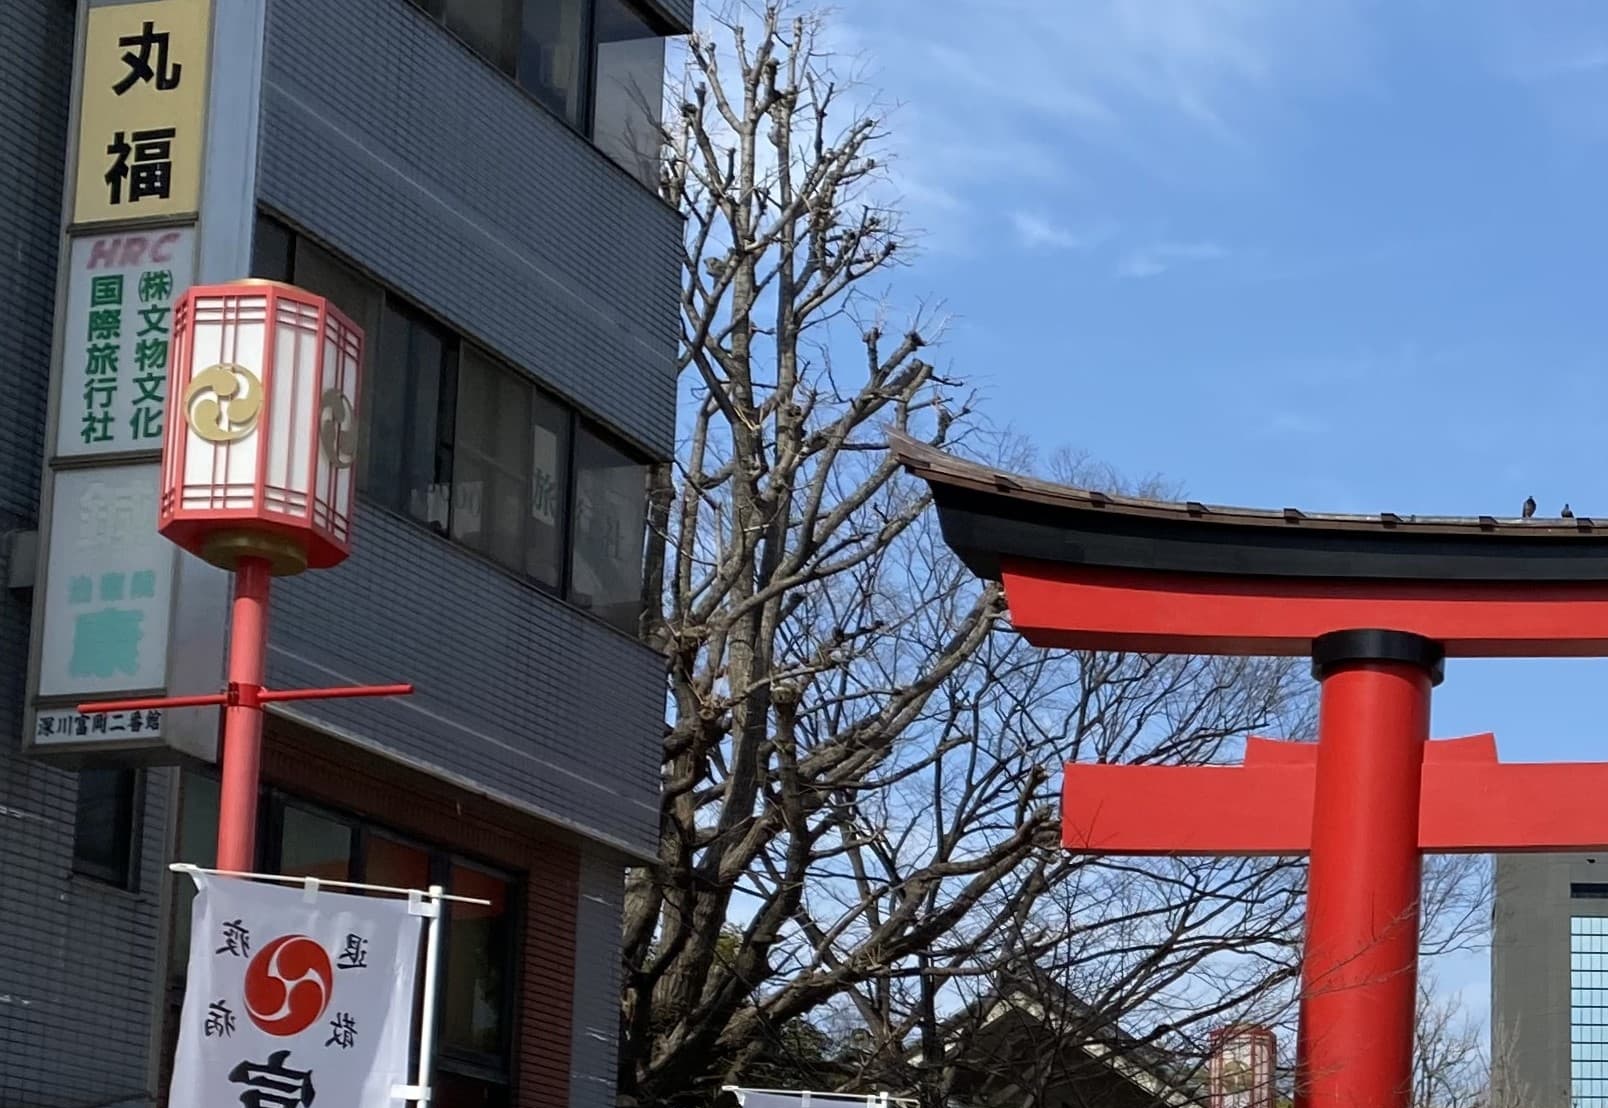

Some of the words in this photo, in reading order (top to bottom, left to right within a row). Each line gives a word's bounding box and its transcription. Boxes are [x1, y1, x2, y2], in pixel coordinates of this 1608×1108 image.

[104, 21, 182, 205] 丸福
[80, 274, 124, 444] 国際旅行社
